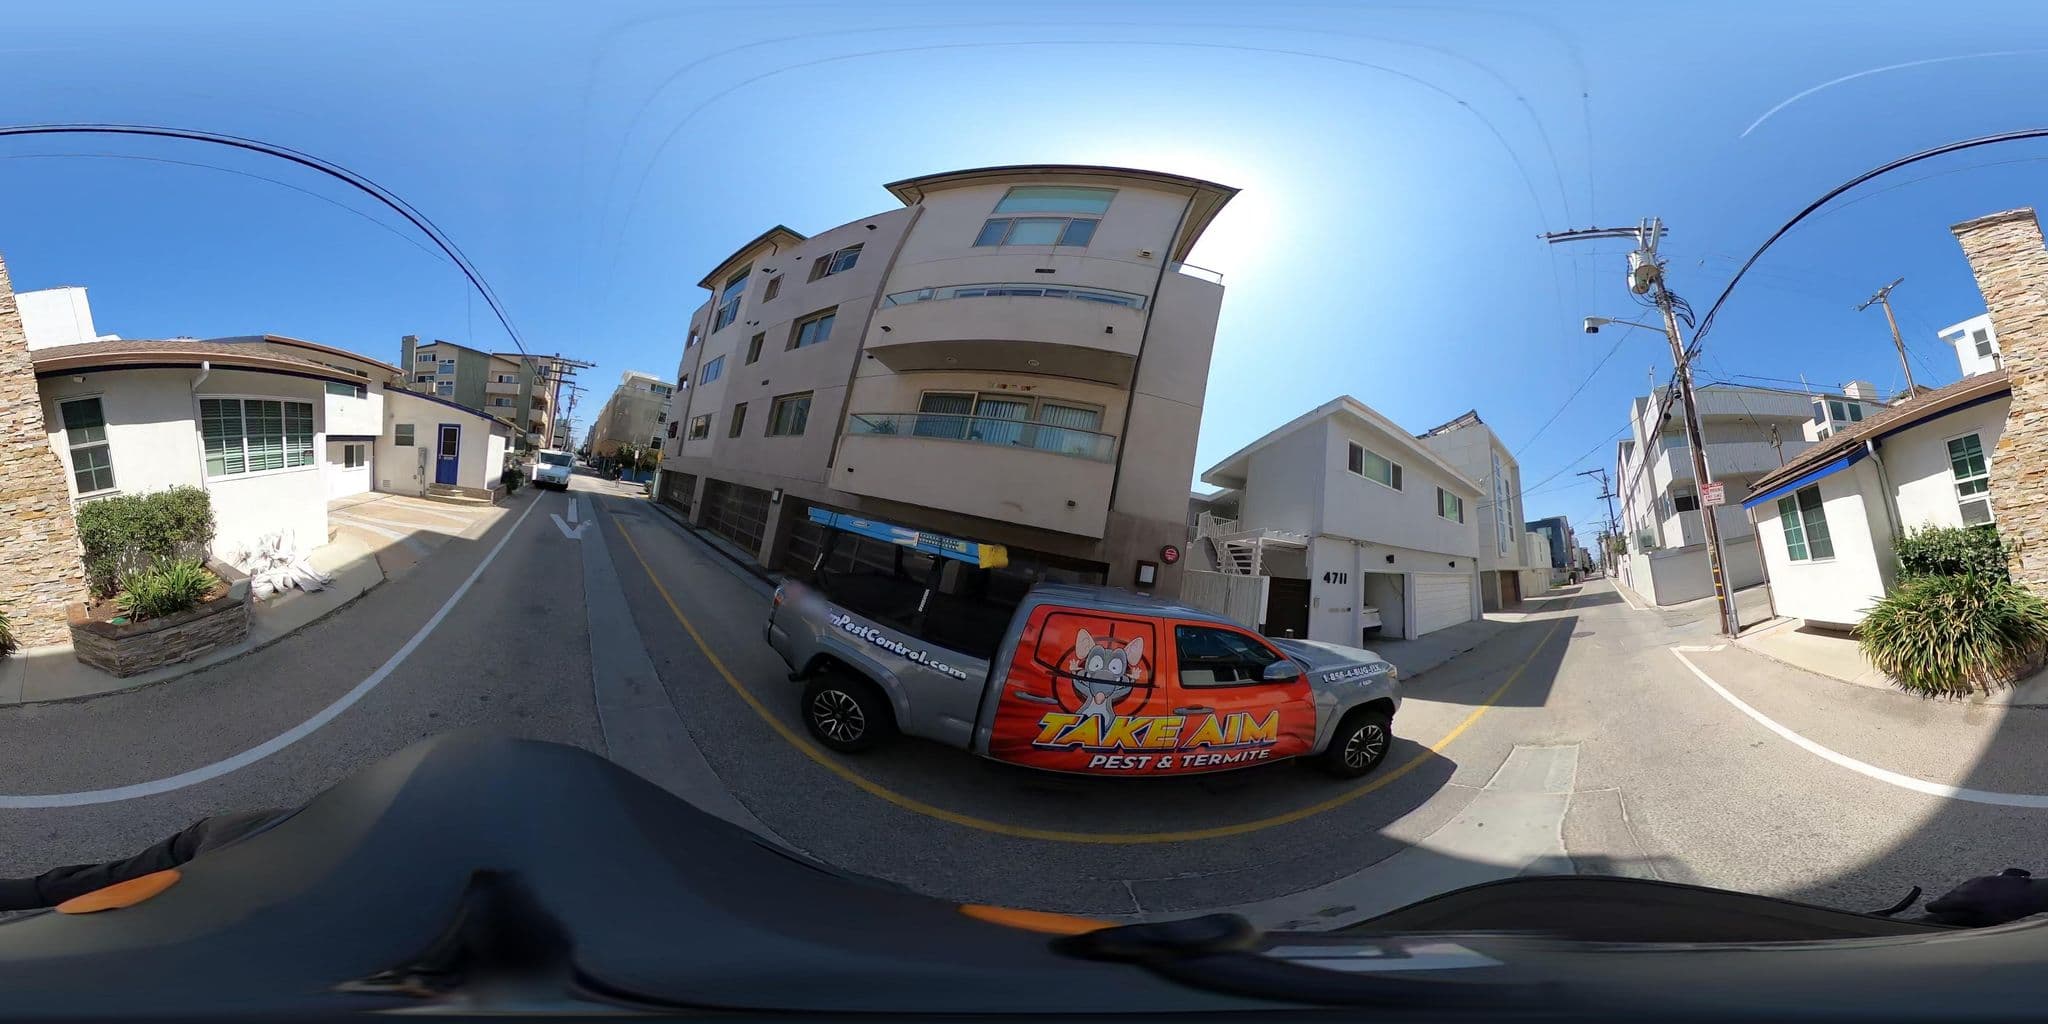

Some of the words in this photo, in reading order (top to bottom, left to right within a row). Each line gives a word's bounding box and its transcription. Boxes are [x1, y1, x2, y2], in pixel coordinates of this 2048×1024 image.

[1323, 572, 1347, 584] 4711
[829, 608, 967, 680] mPestControl.com
[1032, 712, 1186, 751] TAKE
[1182, 710, 1279, 749] AIM
[1089, 755, 1151, 769] PEST
[1157, 755, 1173, 768] &
[1182, 749, 1271, 767] TERMITE
